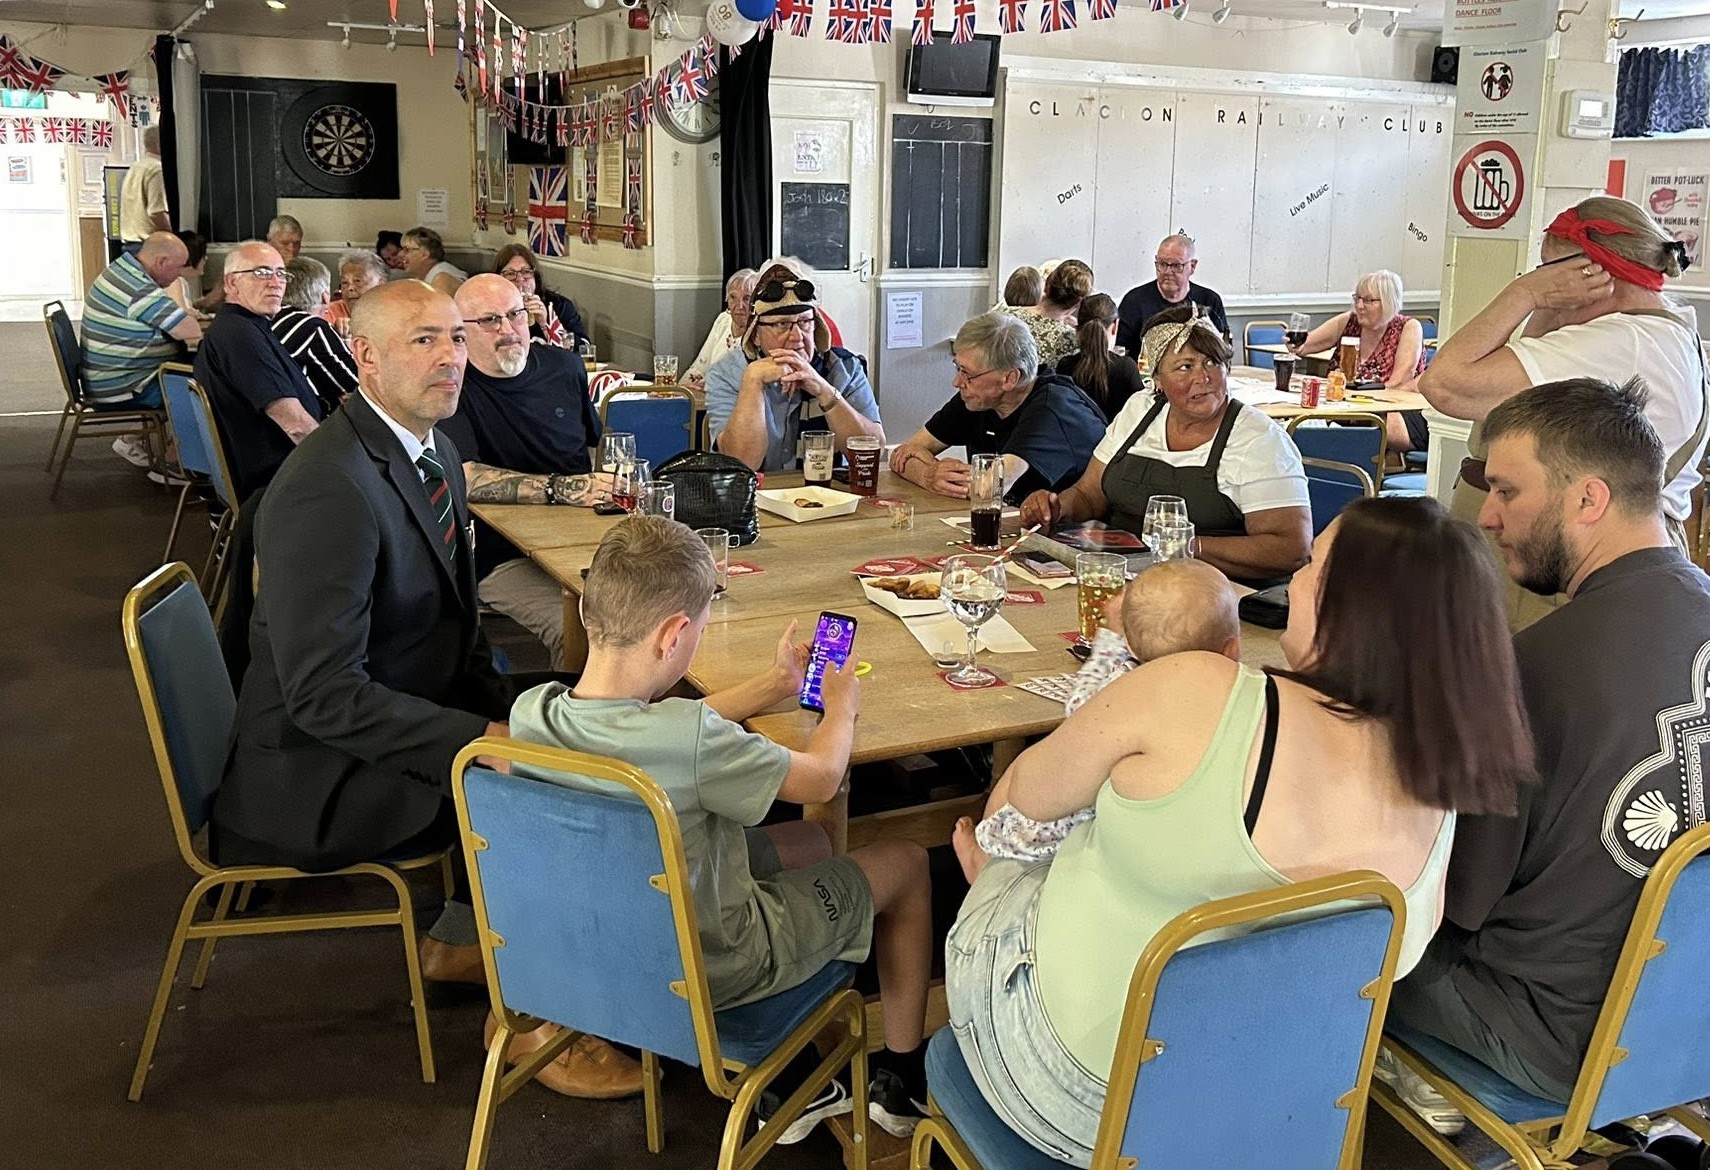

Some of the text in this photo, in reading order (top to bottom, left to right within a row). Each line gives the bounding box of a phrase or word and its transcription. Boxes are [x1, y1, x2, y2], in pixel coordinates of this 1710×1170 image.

[1384, 118, 1443, 134] CLUB
[1650, 175, 1705, 185] BETTER POT-LUCK
[1057, 183, 1082, 204] Darts
[1289, 183, 1329, 217] Live Music
[1664, 216, 1687, 226] HUMBLE
[1689, 217, 1700, 226] PIE
[1407, 222, 1428, 242] Bingo
[813, 878, 838, 921] NASA
